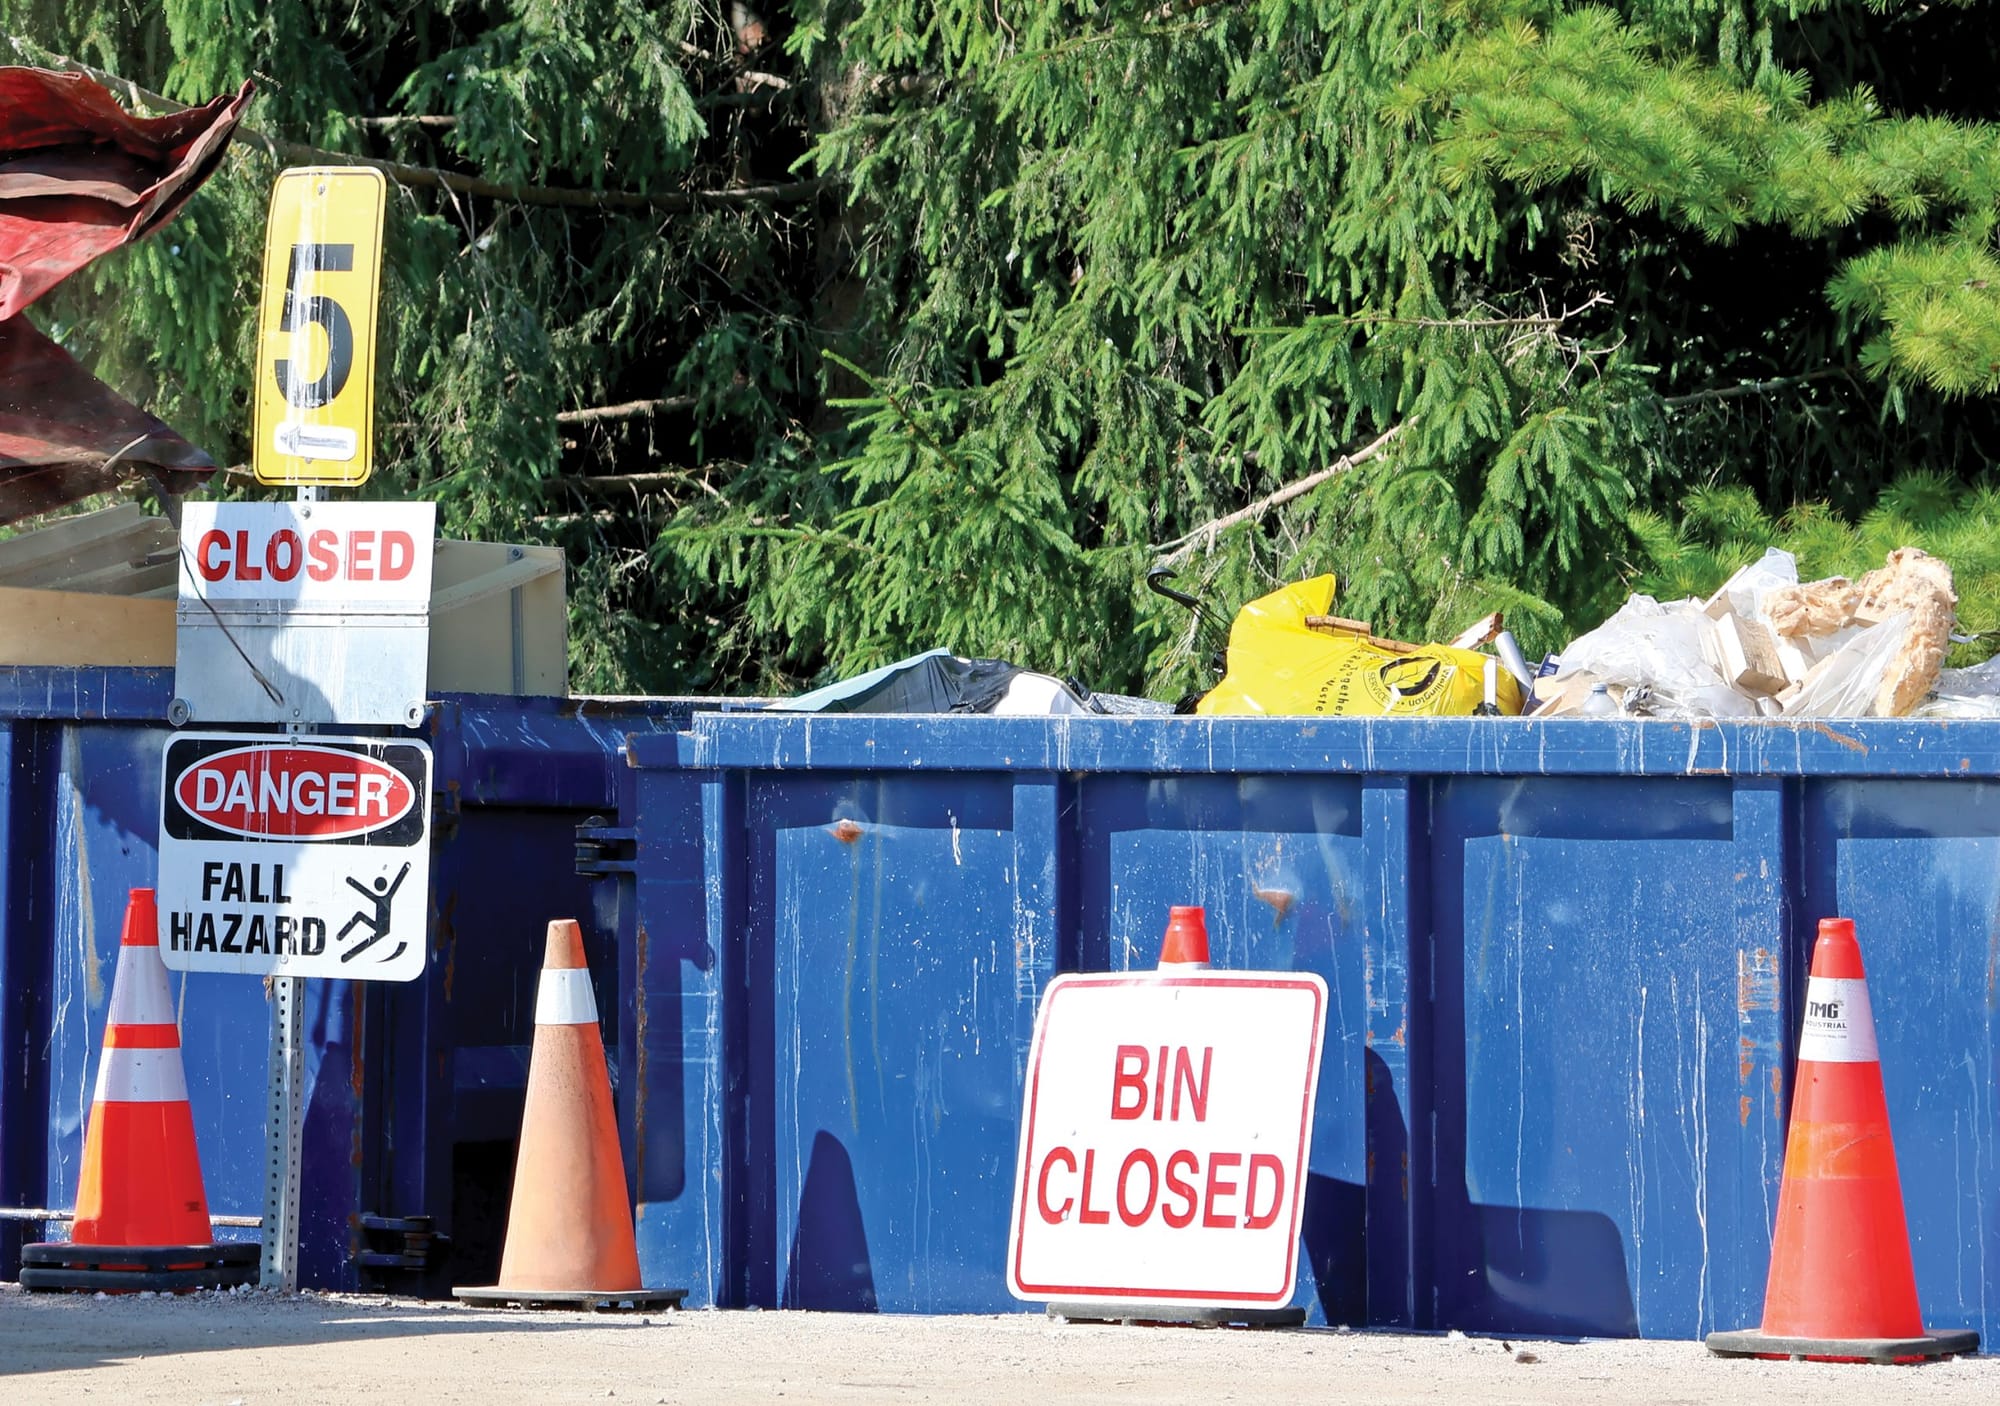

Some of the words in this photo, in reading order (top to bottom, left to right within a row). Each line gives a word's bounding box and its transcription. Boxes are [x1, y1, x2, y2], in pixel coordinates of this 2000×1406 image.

[274, 243, 354, 409] 5
[197, 529, 415, 582] CLOSED
[195, 768, 390, 818] DANGER
[202, 861, 292, 904] FALL
[170, 911, 327, 956] HAZARD
[1809, 1001, 1839, 1019] TMG
[1111, 1045, 1214, 1122] BIN
[1037, 1145, 1286, 1230] CLOSED
